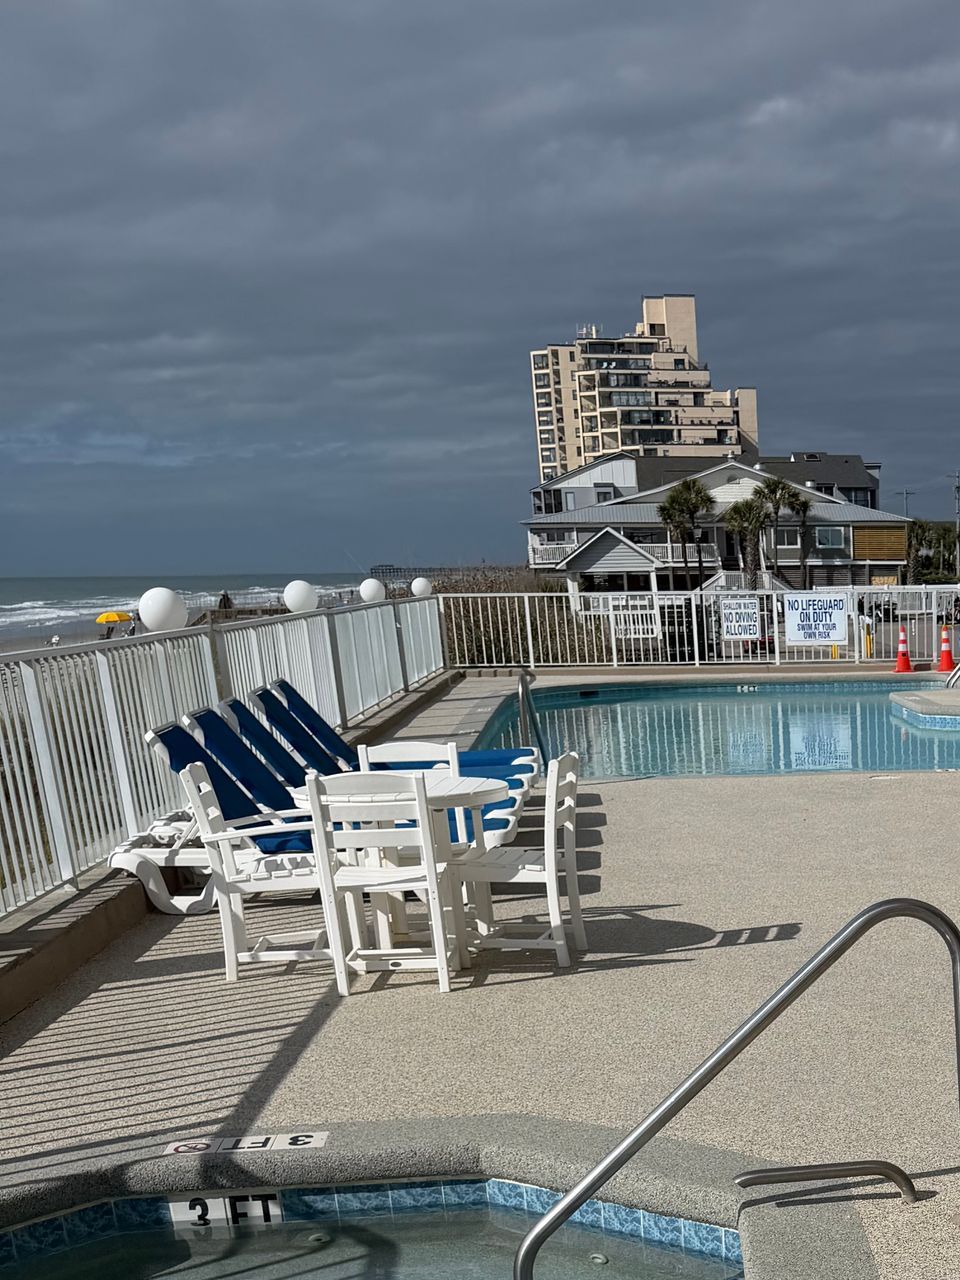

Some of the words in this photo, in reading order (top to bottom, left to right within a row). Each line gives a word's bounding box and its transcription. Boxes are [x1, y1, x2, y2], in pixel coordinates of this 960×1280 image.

[723, 602, 741, 610] SHALLOW
[742, 601, 757, 610] WATER
[788, 599, 800, 611] NO
[801, 599, 844, 611] LIFEGUARD
[723, 611, 734, 623] NO
[735, 611, 758, 623] DIVING
[799, 611, 811, 623] ON
[812, 611, 833, 623] DUTY
[725, 624, 758, 636] ALLOWED
[797, 623, 814, 631] SWIM
[814, 623, 821, 631] AT
[822, 623, 837, 631] YOUR
[803, 631, 817, 639] OWN
[818, 631, 831, 639] RISK
[222, 1136, 272, 1150] FT
[288, 1134, 314, 1147] 3
[188, 1197, 211, 1227] 3
[229, 1193, 278, 1225] FT
